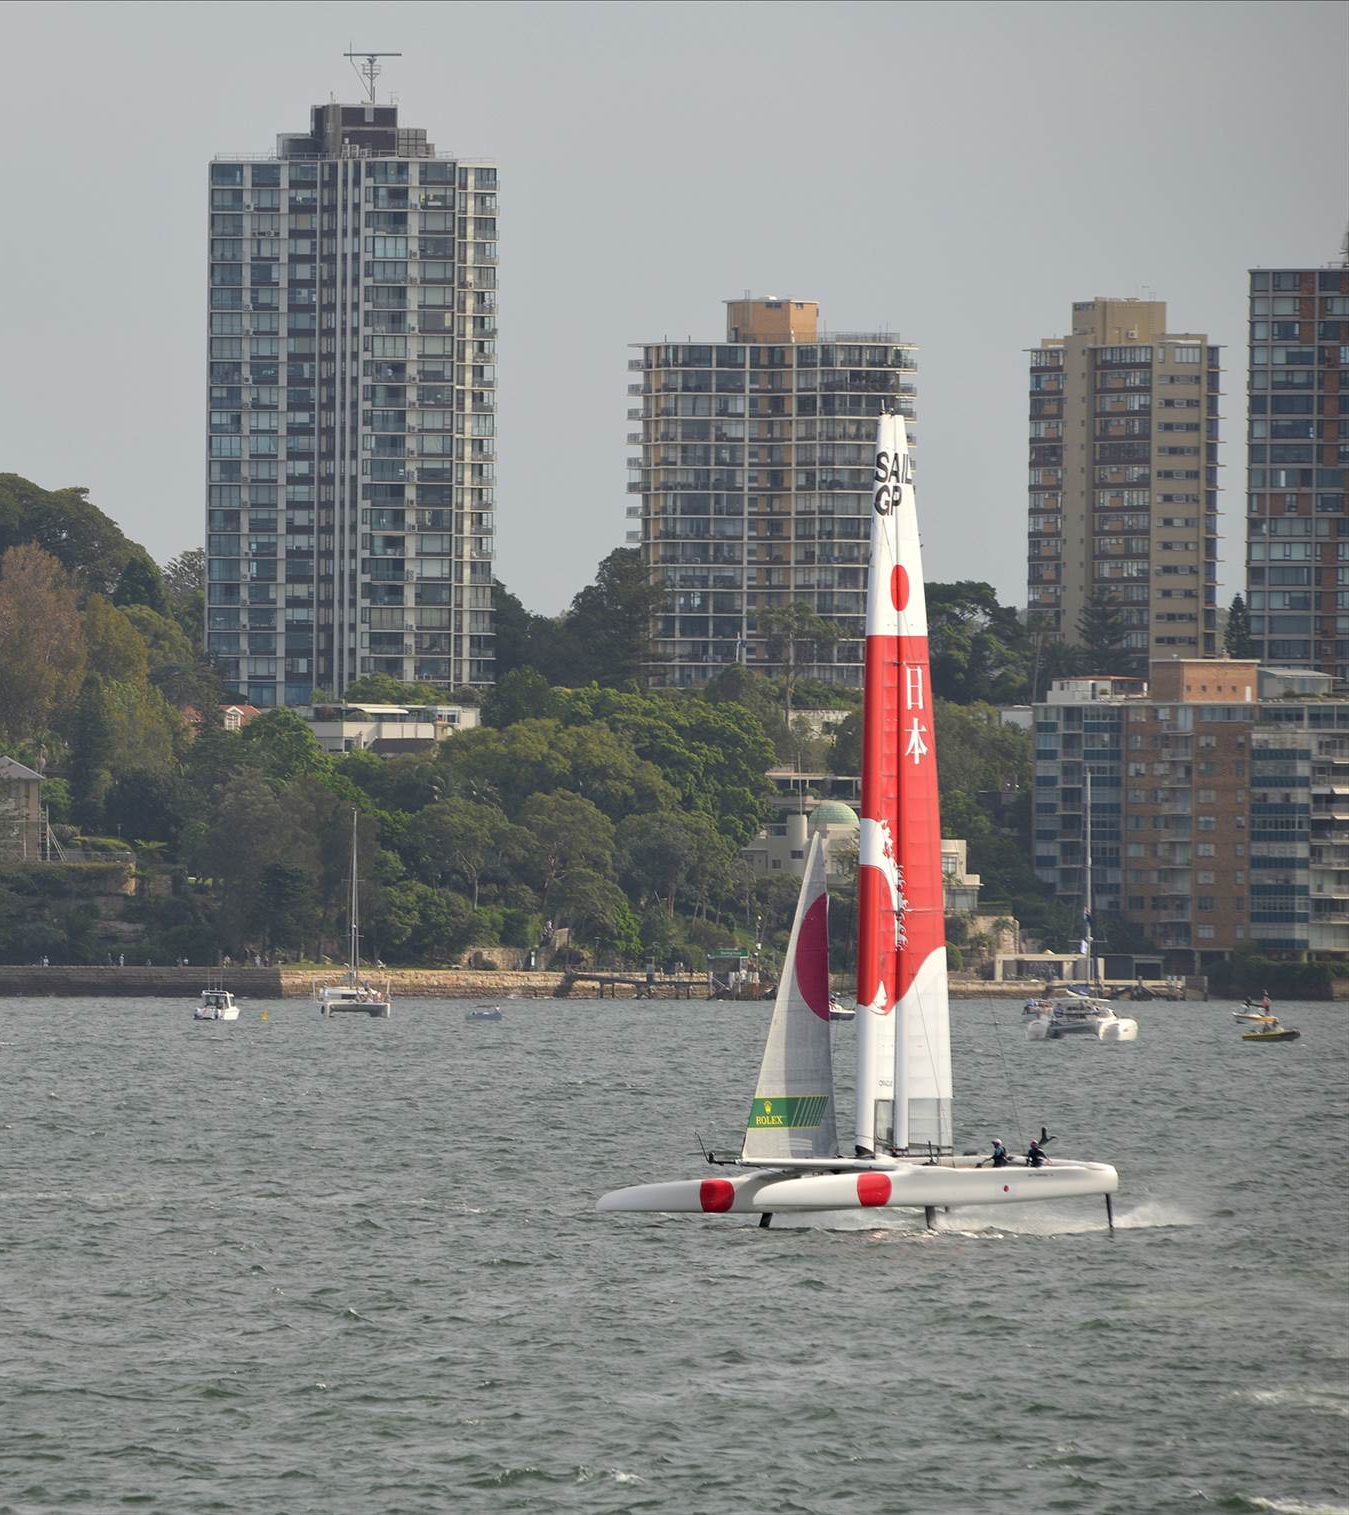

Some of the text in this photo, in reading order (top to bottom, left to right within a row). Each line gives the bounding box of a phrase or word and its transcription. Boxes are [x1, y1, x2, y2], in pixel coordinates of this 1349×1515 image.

[874, 451, 913, 485] SAIL
[874, 485, 903, 516] GP
[905, 666, 928, 765] 日本
[756, 1115, 783, 1125] ROLEX
